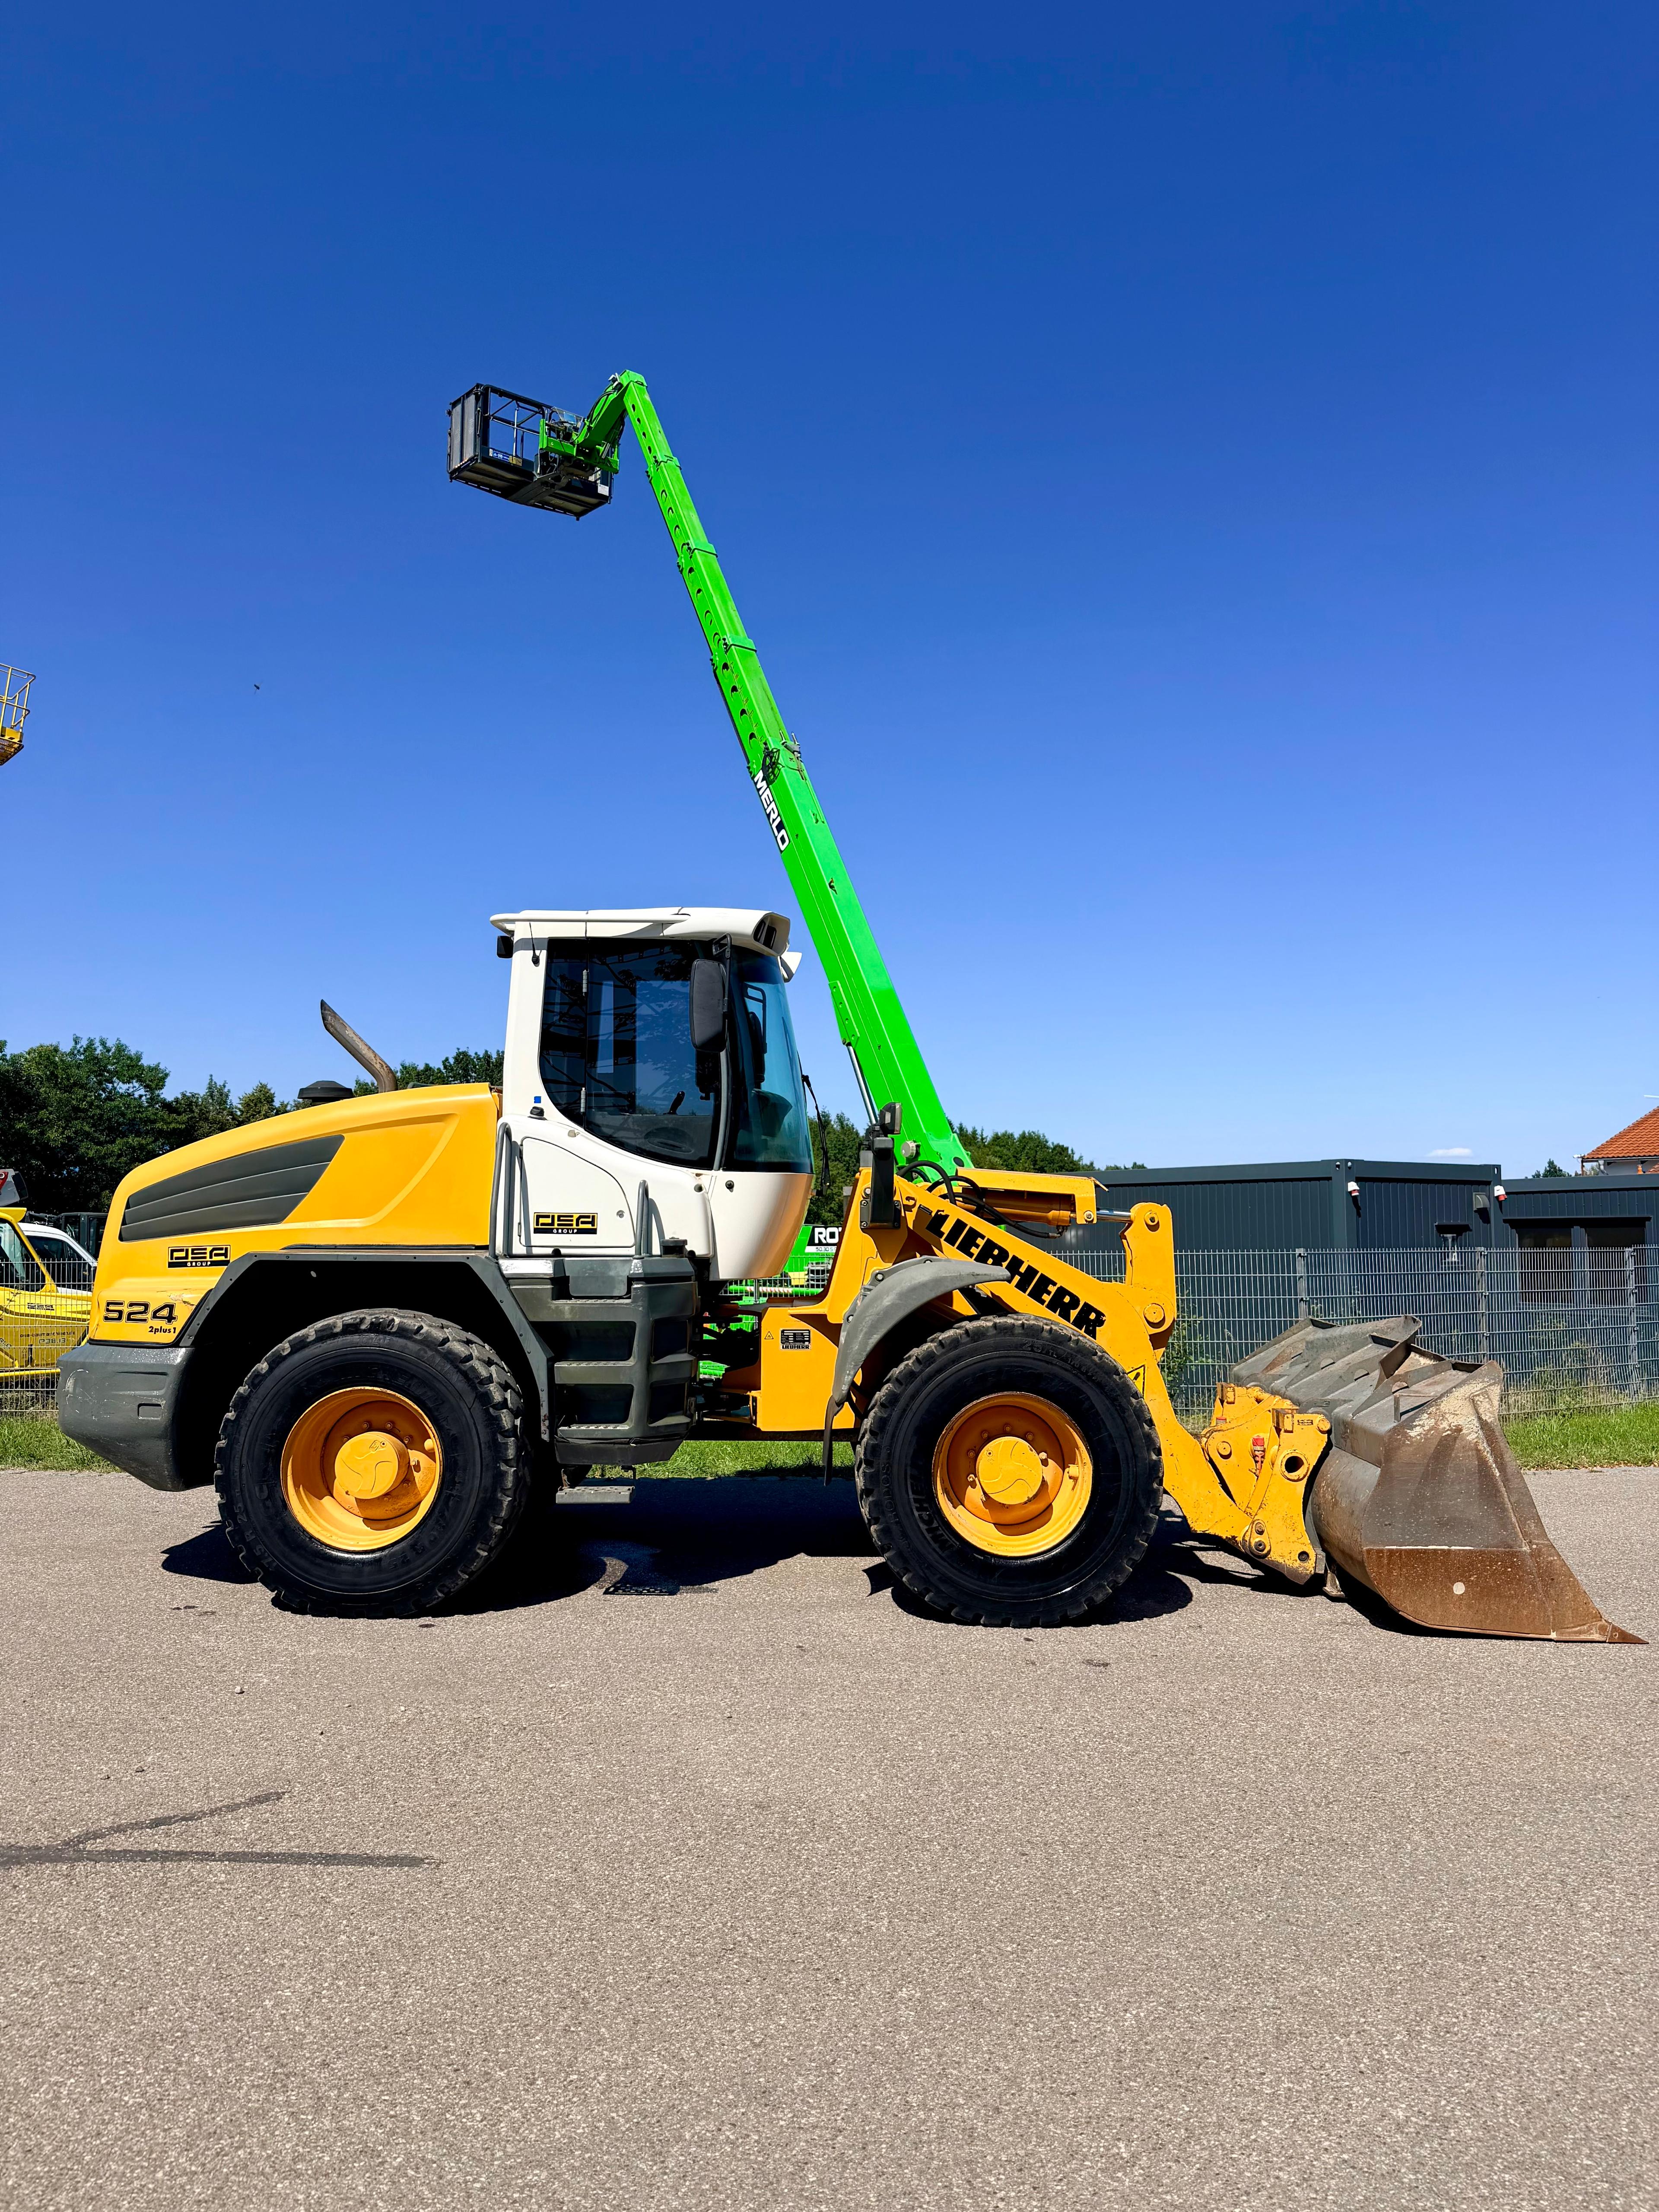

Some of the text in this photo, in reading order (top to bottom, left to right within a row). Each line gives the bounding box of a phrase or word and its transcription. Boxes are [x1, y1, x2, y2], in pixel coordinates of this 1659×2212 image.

[754, 769, 789, 851] MERLO
[925, 1209, 1106, 1340] LIEBHERR
[103, 1300, 178, 1325] 524
[149, 1326, 176, 1334] 2plus1
[416, 1347, 462, 1385] CARRY
[232, 1502, 248, 1525] 25
[242, 1529, 256, 1542] R
